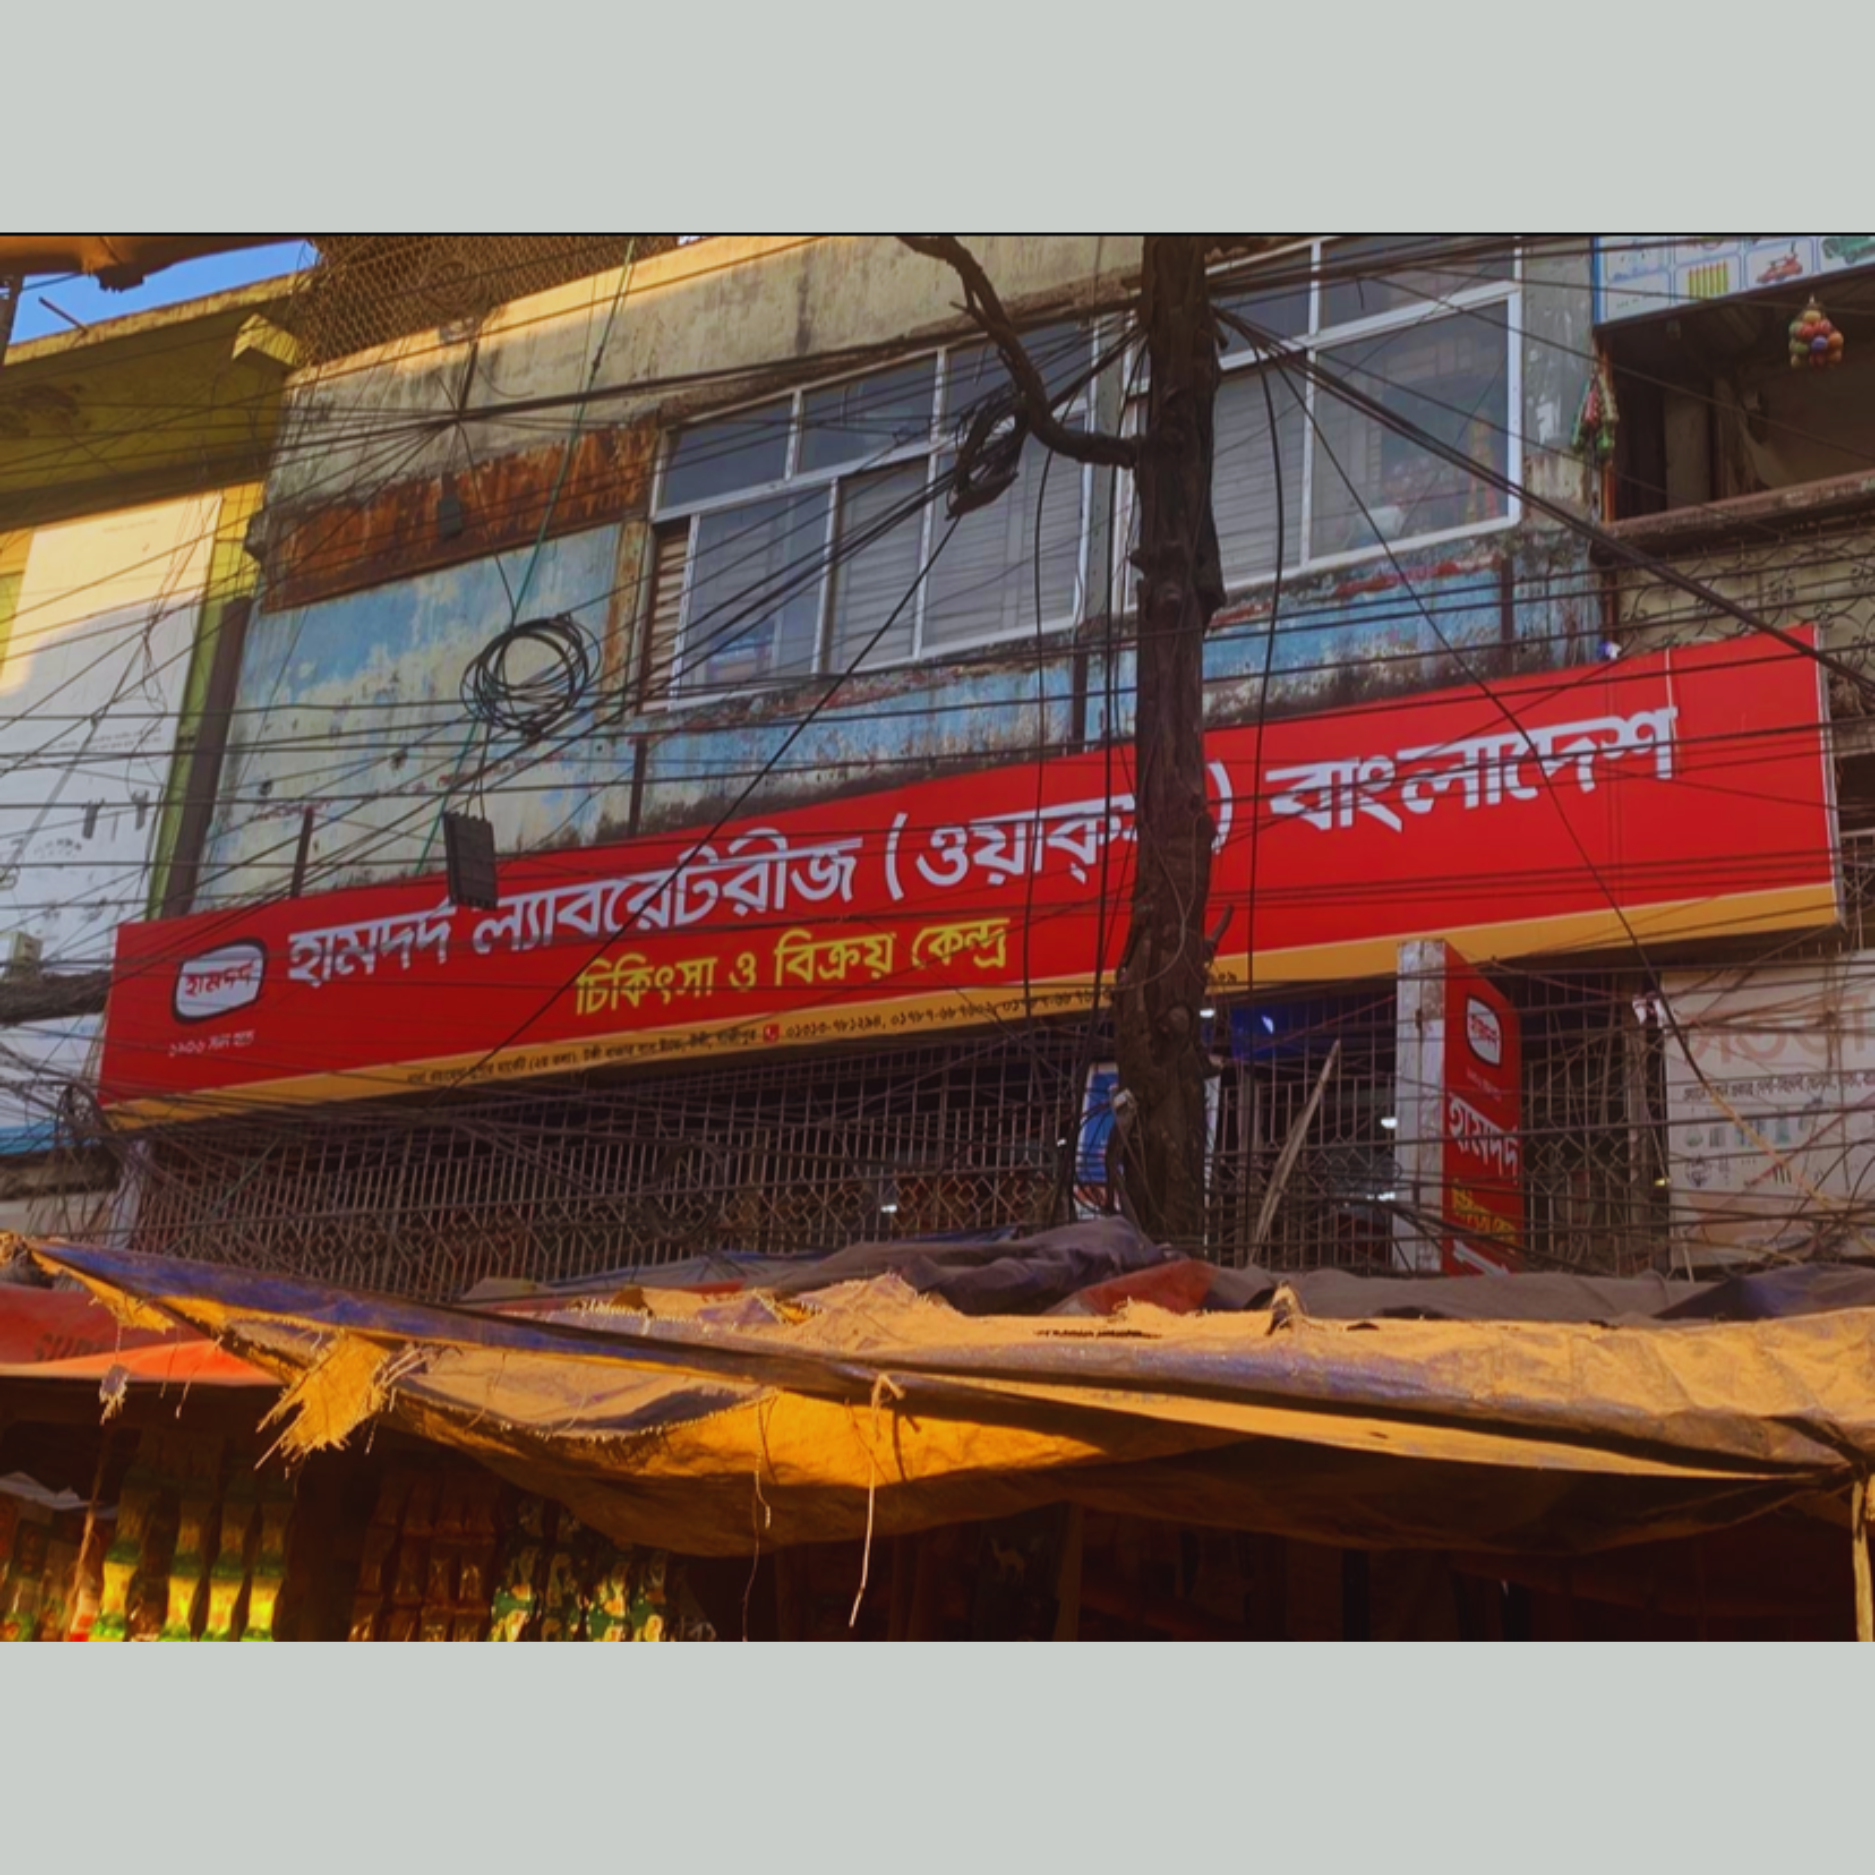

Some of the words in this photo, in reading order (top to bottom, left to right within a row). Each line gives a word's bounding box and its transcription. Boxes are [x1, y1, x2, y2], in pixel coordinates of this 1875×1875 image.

[287, 899, 457, 988] হামদর্দ
[473, 826, 863, 954] ল্যাবরেটরীজ
[1265, 706, 1679, 833] বাংলাদেশ
[575, 952, 718, 1015] চিকিৎসা
[728, 952, 757, 991] ও
[774, 927, 896, 986] বিক্রয়
[911, 916, 1011, 969] কেন্দ্র
